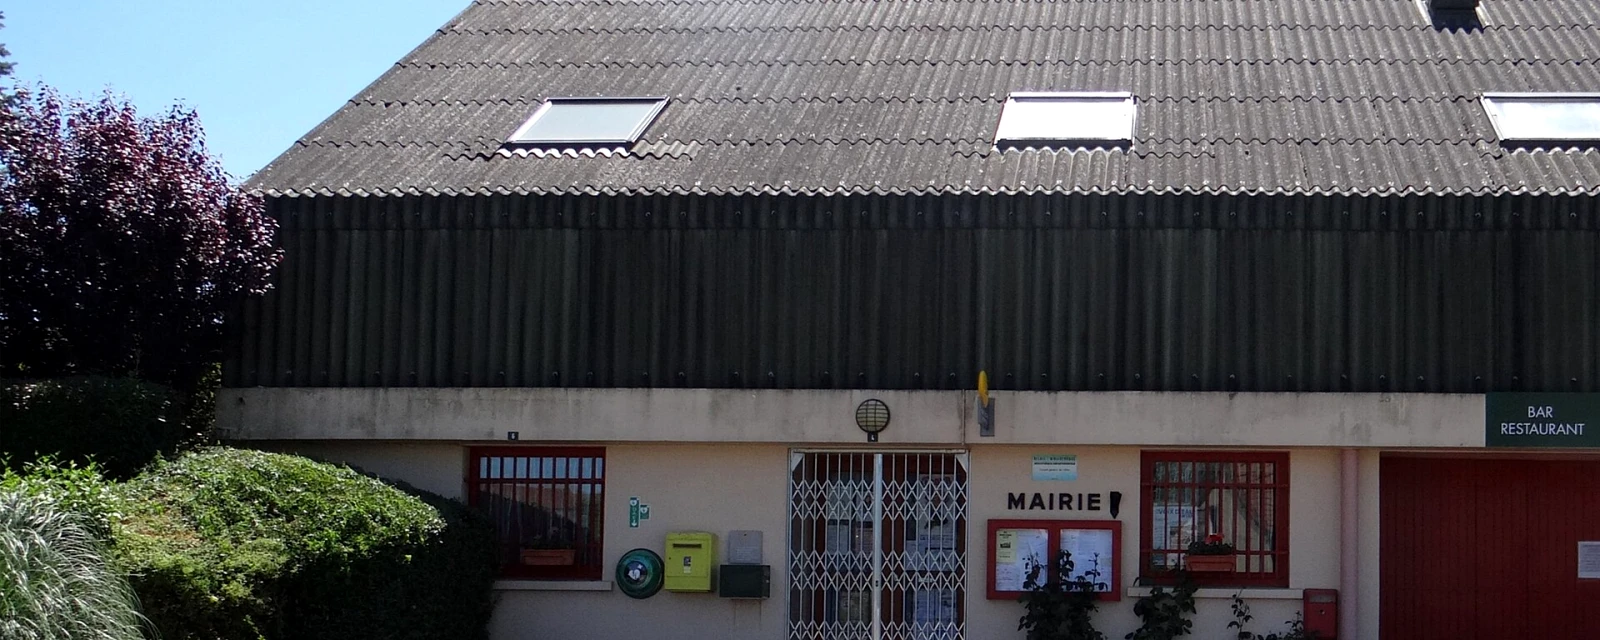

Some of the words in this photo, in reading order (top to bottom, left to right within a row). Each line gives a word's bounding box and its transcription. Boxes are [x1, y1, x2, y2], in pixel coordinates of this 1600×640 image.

[1527, 406, 1553, 418] BAR
[1500, 422, 1585, 435] RESTAURANT
[1007, 492, 1101, 511] MAIRIE
